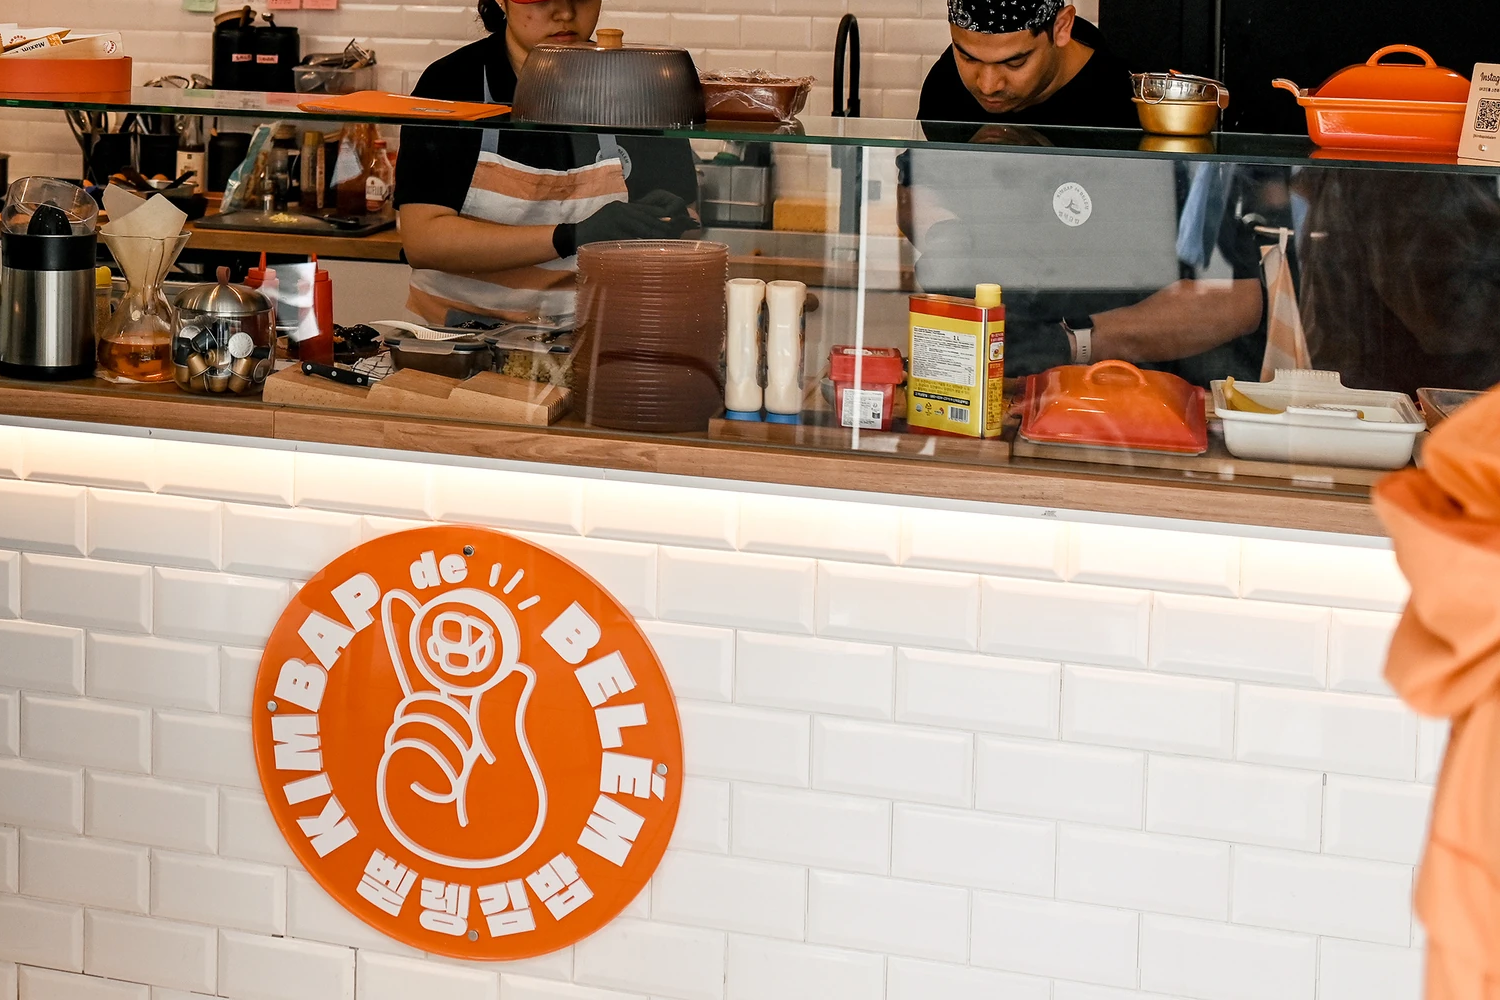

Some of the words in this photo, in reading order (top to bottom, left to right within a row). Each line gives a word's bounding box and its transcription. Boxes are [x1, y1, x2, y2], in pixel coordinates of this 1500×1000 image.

[271, 572, 381, 858] KIMBAP
[409, 550, 469, 590] de
[540, 600, 666, 867] BELÉM
